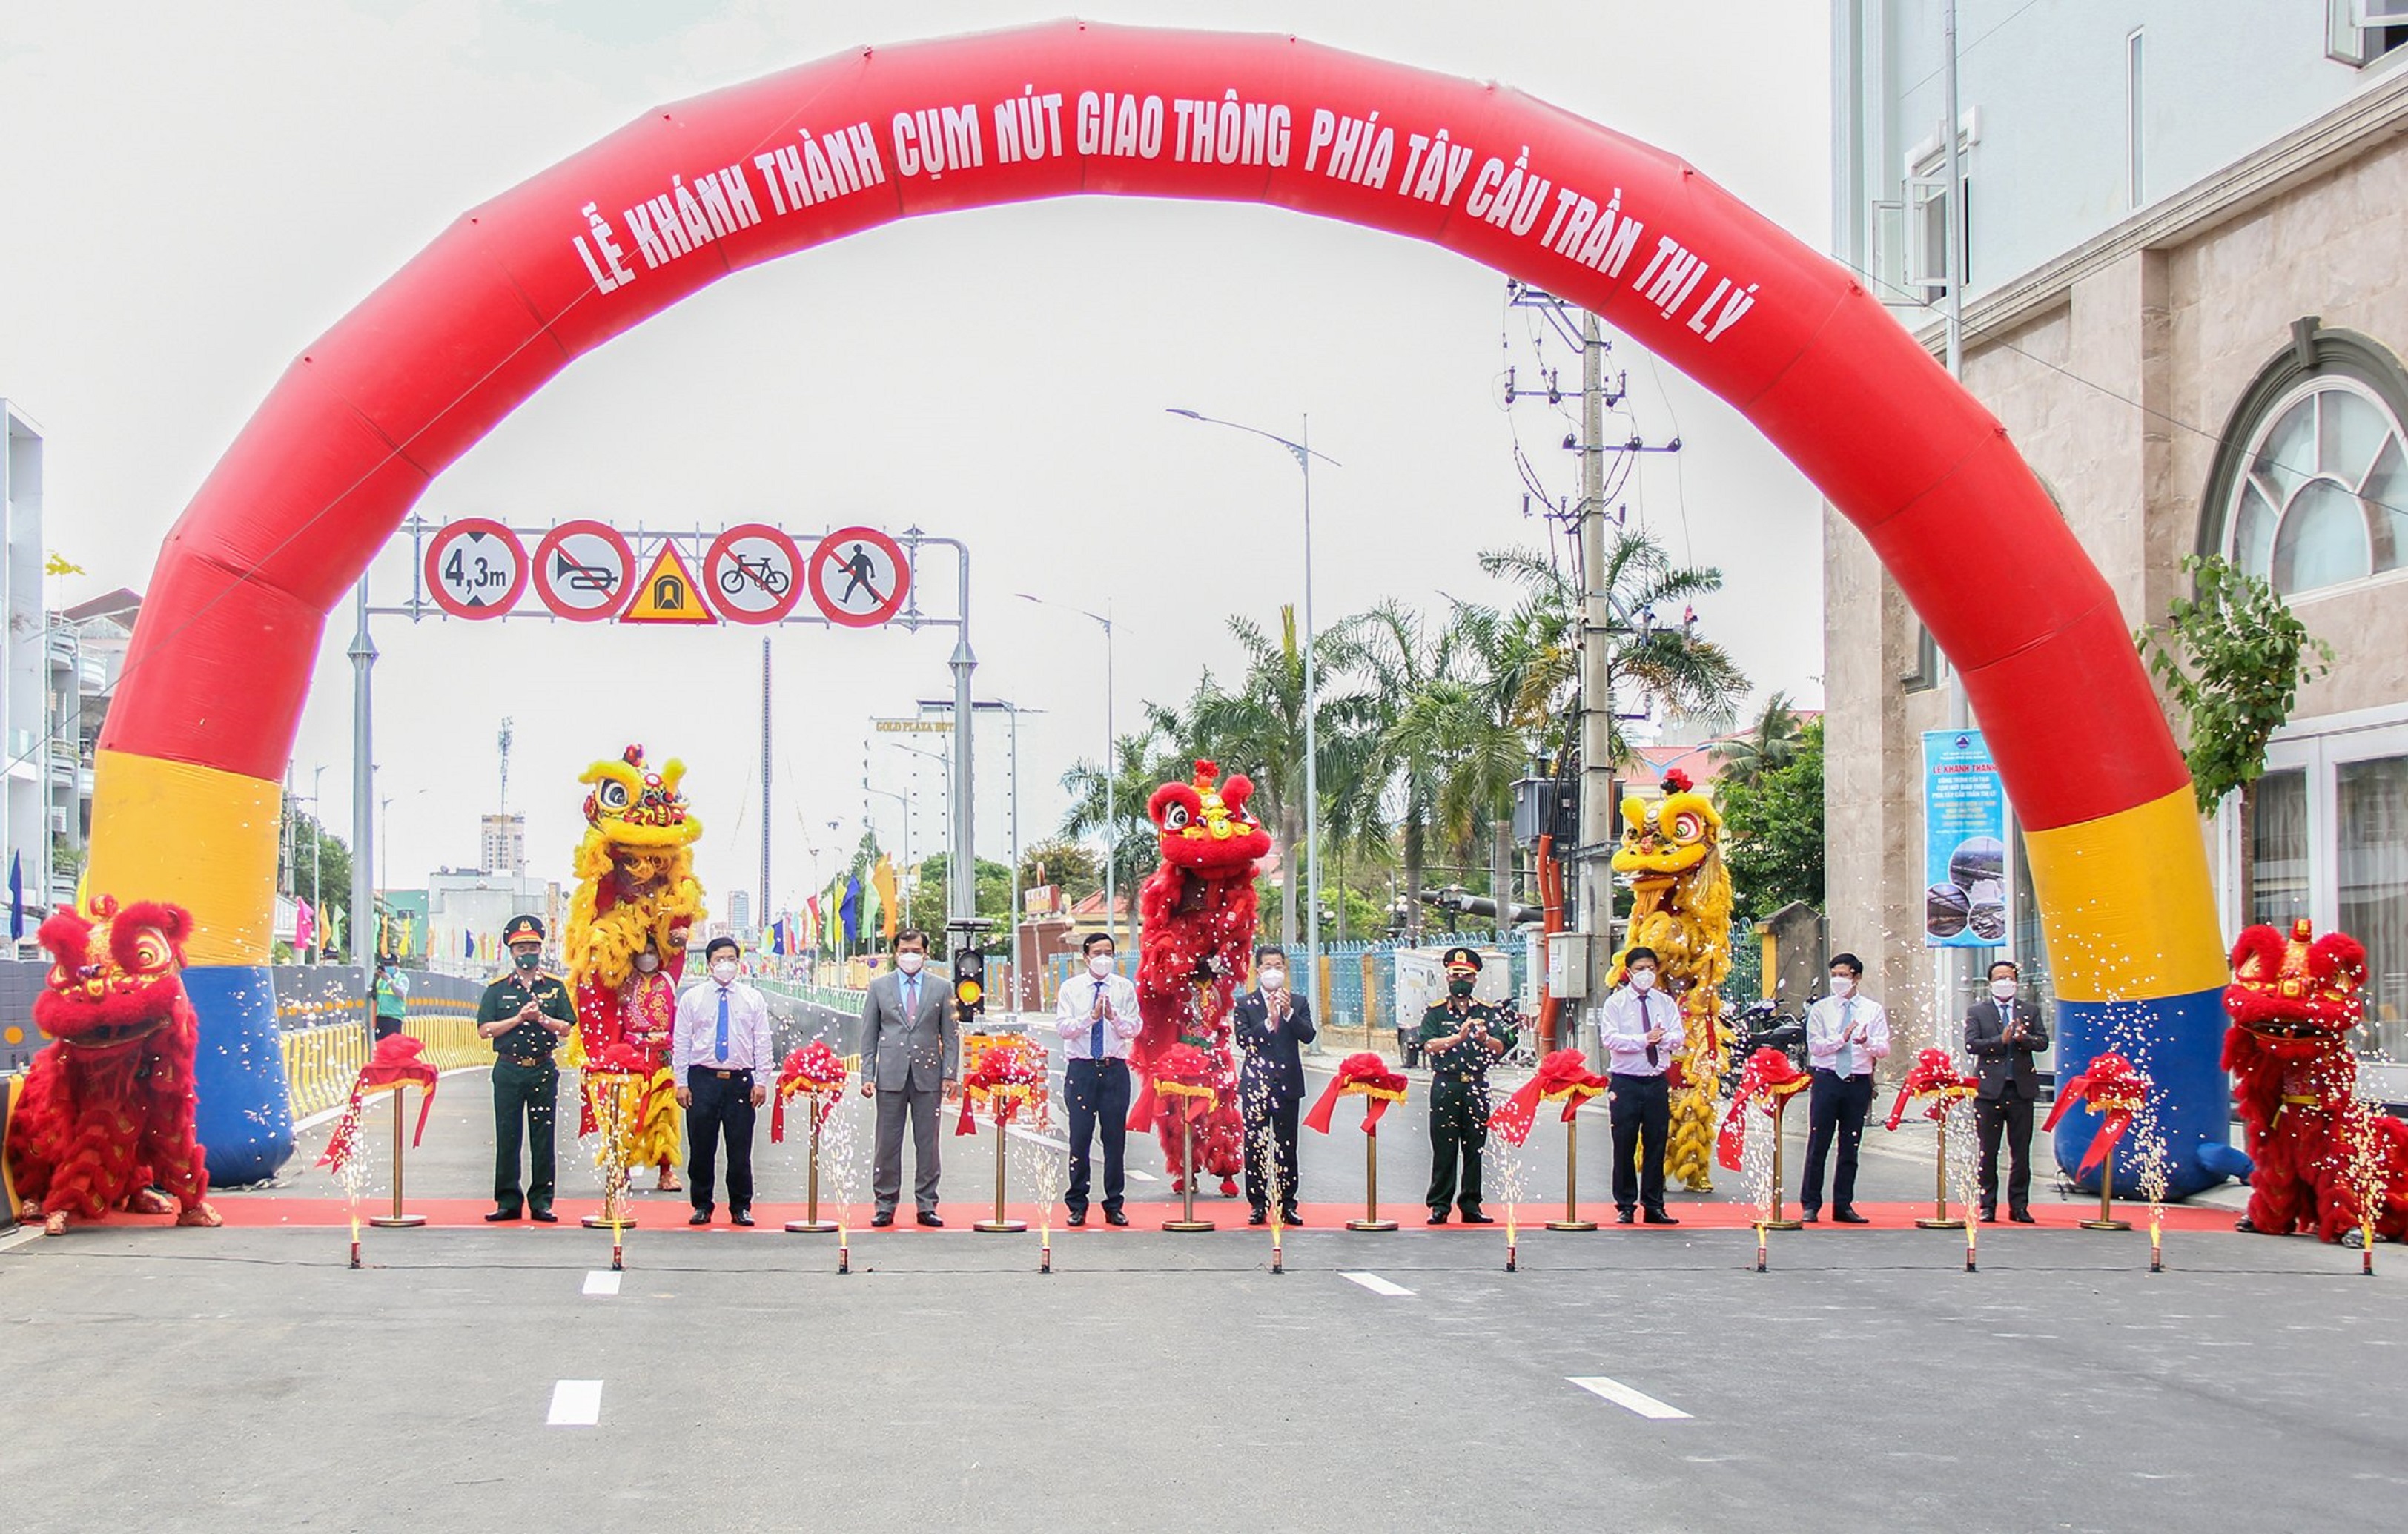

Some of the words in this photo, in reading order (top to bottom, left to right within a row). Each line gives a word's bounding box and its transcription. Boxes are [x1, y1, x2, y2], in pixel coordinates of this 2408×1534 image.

[573, 202, 635, 294] LỄ
[624, 165, 761, 268] KHÁNH
[754, 122, 885, 215] THÀNH
[893, 105, 982, 179] CỤM
[995, 85, 1062, 162] NÚT
[1078, 92, 1162, 158] GIAO
[1174, 89, 1290, 166] THÔNG
[1306, 110, 1393, 189] PHÍA
[1400, 129, 1472, 205] TÂY
[1467, 146, 1550, 235] CẦU
[1541, 188, 1643, 277] TRẦN
[1633, 236, 1708, 320] THỊ
[1687, 278, 1759, 342] LÝ
[446, 549, 506, 594] 4,3m
[876, 721, 901, 732] GOLD
[902, 721, 933, 732] PLAZA
